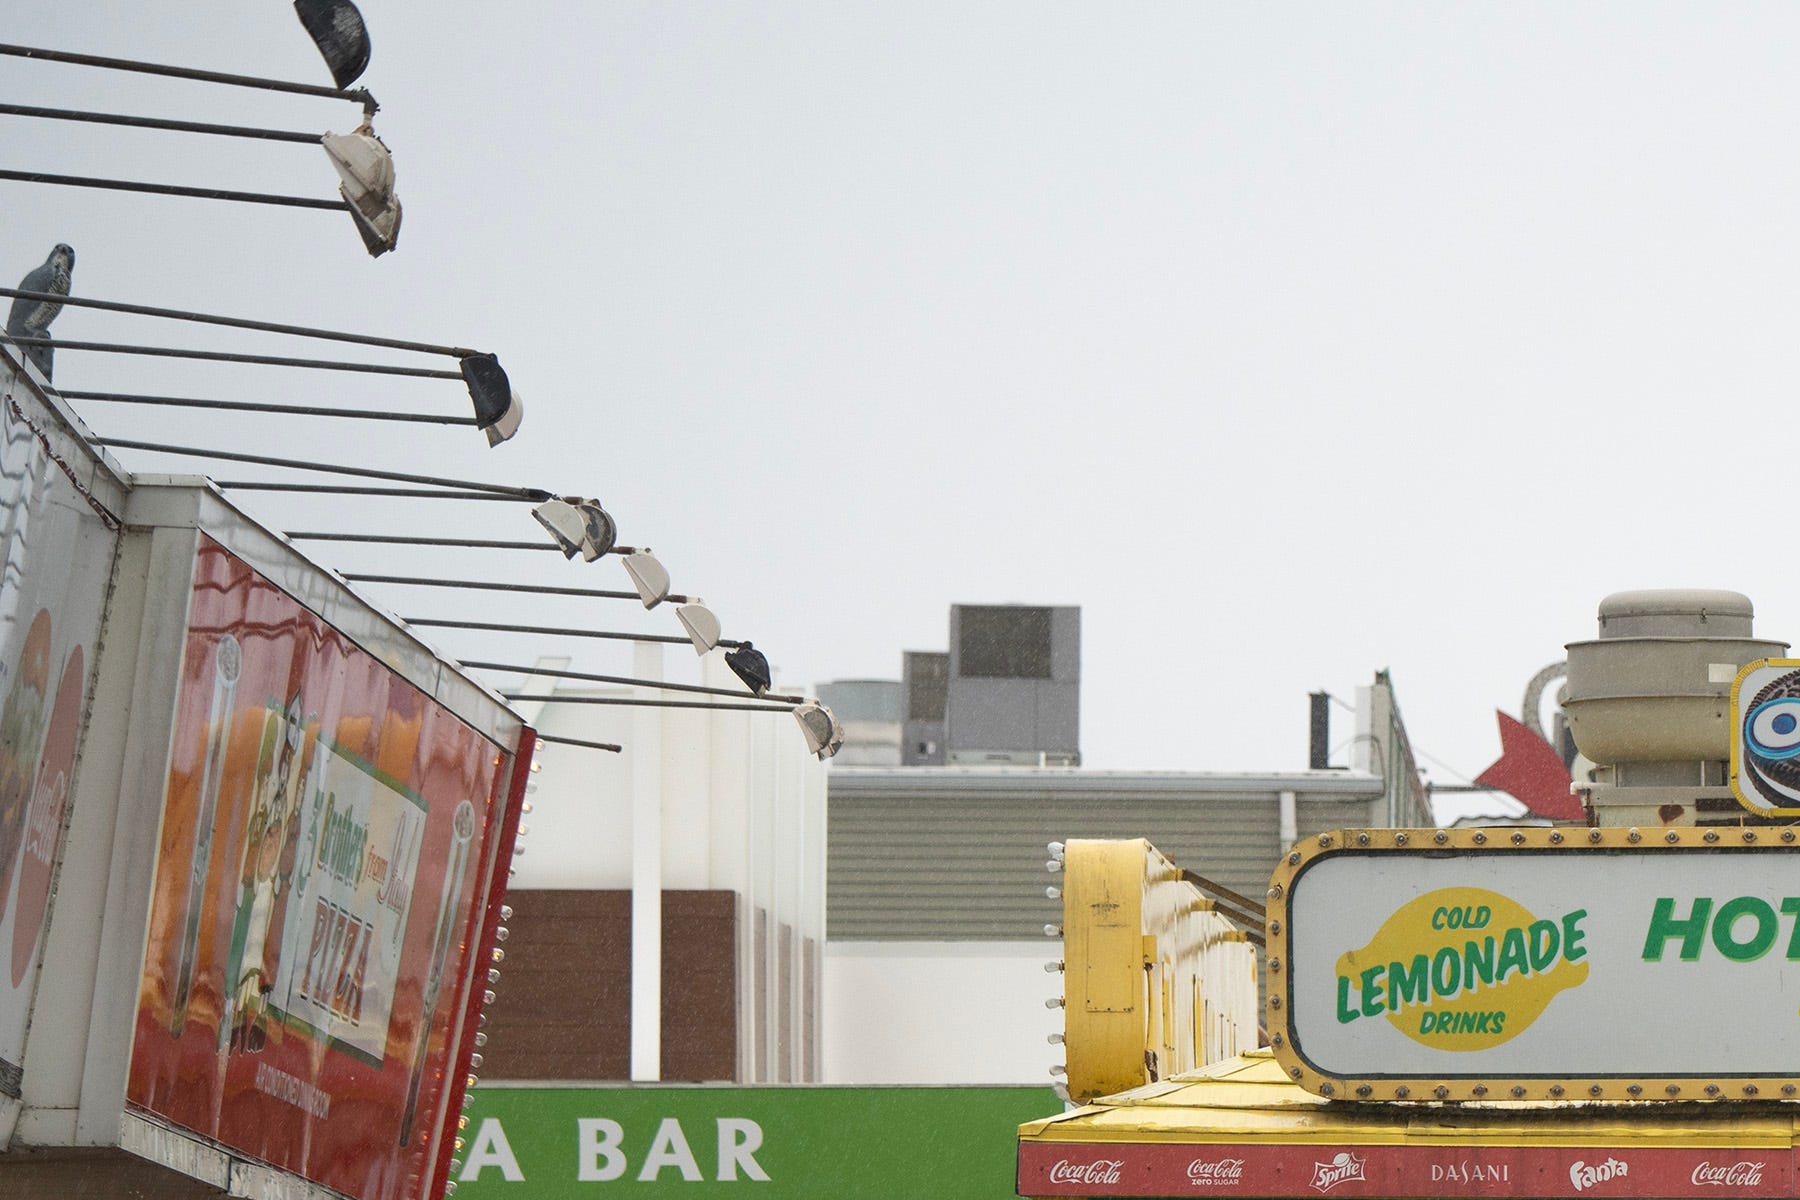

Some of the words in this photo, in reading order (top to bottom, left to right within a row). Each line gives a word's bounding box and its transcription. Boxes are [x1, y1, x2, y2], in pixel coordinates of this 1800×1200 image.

[1431, 905, 1491, 931] COLD
[1336, 909, 1588, 1024] LEMONADE
[1419, 1010, 1506, 1036] DRINKS
[577, 1117, 771, 1182] BAR
[1050, 1159, 1126, 1185] Coca-Cola
[1187, 1159, 1245, 1179] Coca-Cola
[1213, 1178, 1239, 1186] SUGAR
[1315, 1161, 1360, 1188] Sprite
[1431, 1164, 1509, 1184] DASANI
[1569, 1157, 1629, 1191] Fanta
[1691, 1160, 1766, 1188] Coca-Cola
